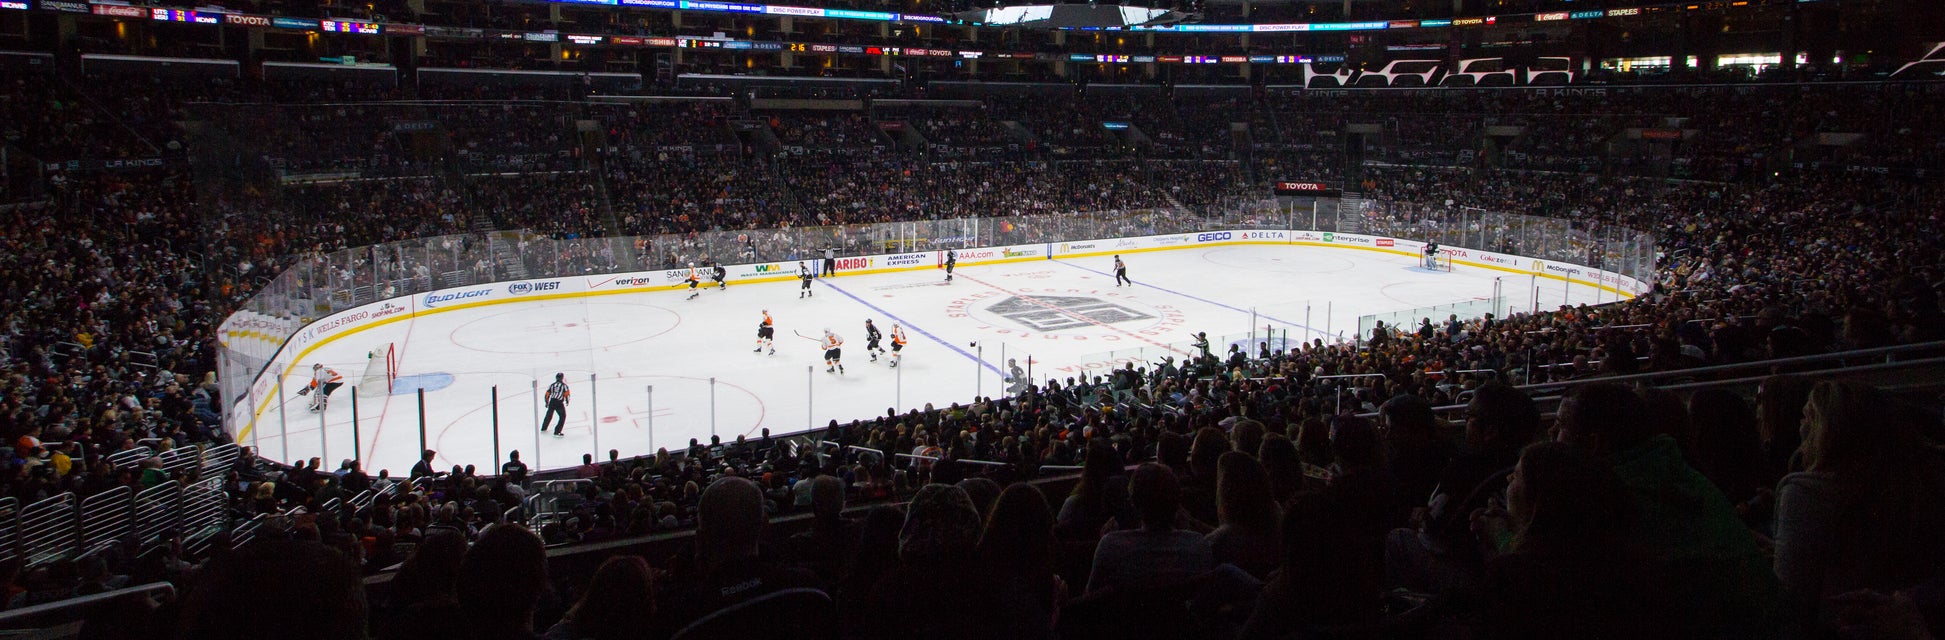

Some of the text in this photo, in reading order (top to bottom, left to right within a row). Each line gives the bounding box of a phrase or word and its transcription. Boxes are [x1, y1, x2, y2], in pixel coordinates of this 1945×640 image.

[1608, 8, 1638, 16] STAPLES
[226, 15, 270, 25] TOYOTA
[1554, 88, 1607, 96] KINGS
[106, 158, 163, 168] LA KINGS
[1285, 182, 1318, 190] TOYOTA
[1198, 231, 1232, 242] GEICO
[888, 253, 926, 261] AMERICAN
[959, 251, 993, 259] AAA.com
[1480, 254, 1496, 263] Coke
[833, 257, 867, 271] ARIBO
[1547, 264, 1580, 275] McDonald's
[667, 271, 683, 279] SAN
[513, 281, 560, 291] FOX WEST
[615, 276, 650, 286] verizon
[428, 288, 492, 305] BUD LIGHT
[316, 311, 369, 335] WELLS FARGO
[828, 335, 837, 345] 5
[721, 577, 763, 597] Reebok
